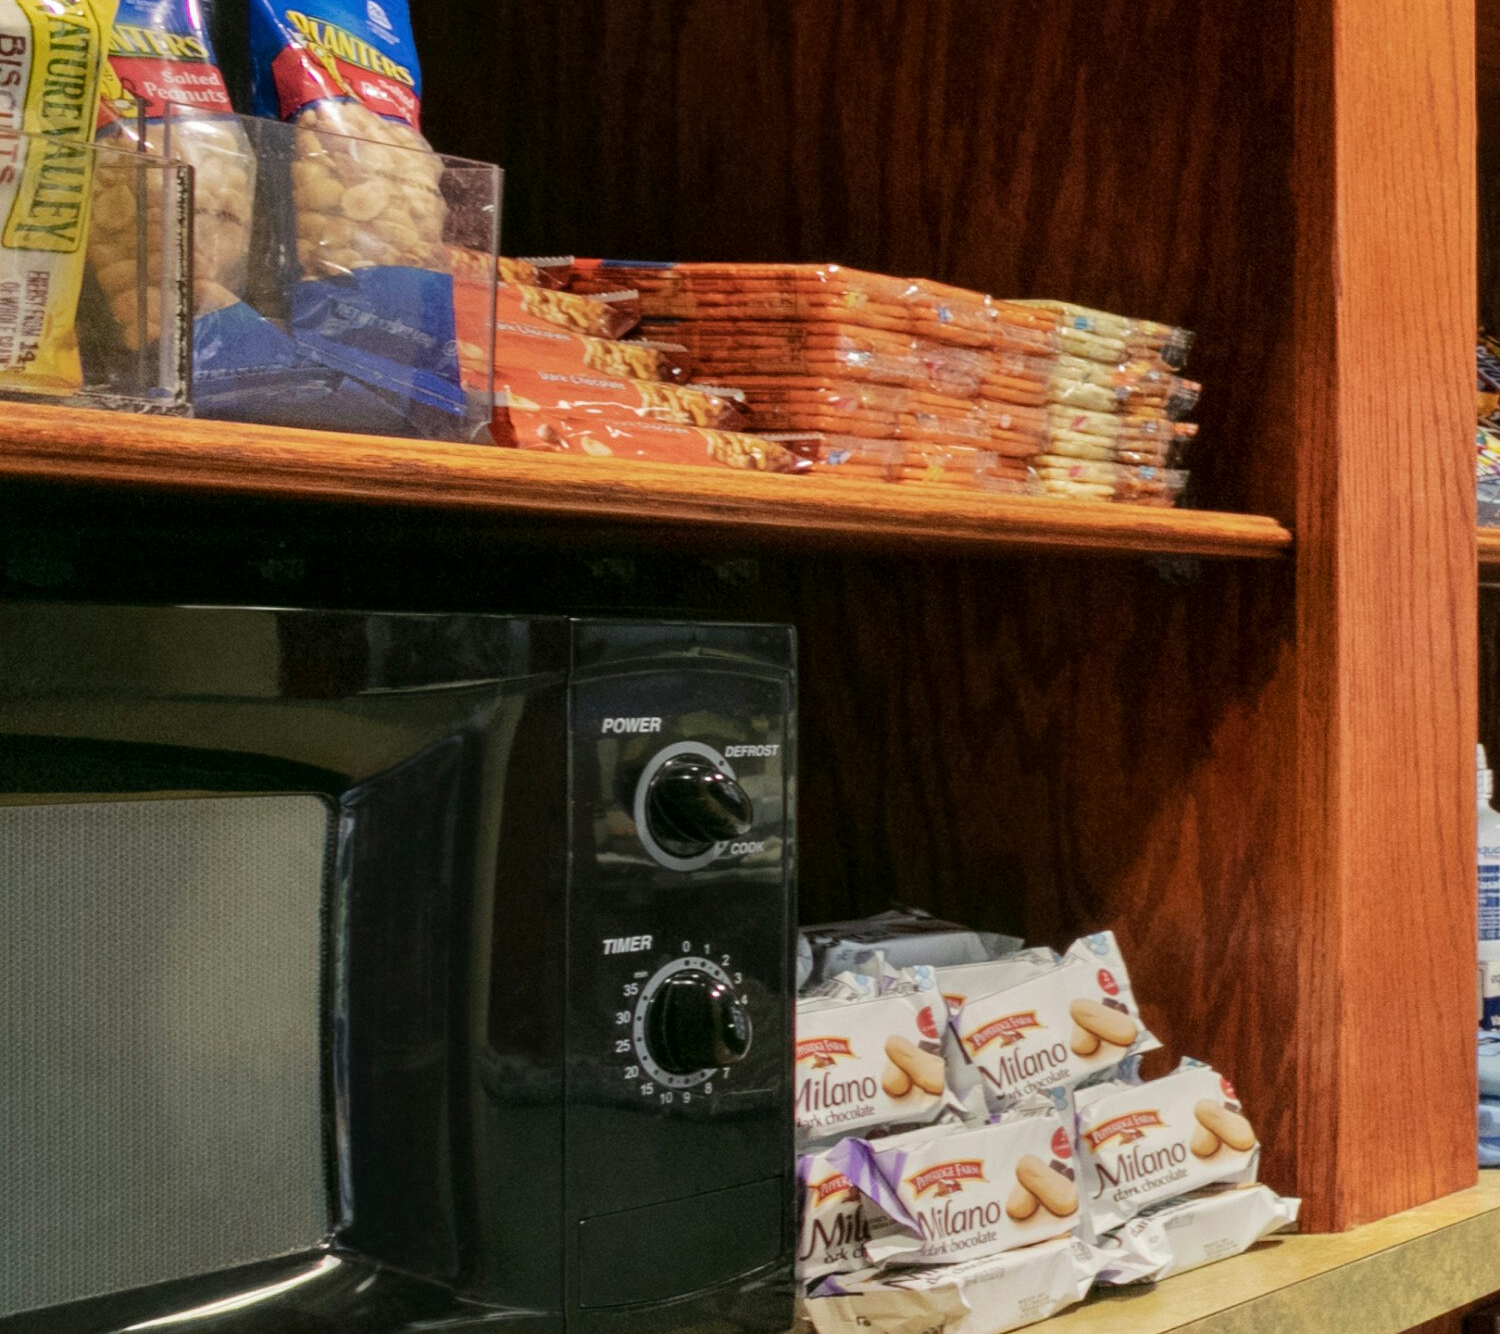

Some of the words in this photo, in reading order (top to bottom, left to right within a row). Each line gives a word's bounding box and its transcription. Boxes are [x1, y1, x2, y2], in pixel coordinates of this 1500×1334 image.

[286, 10, 415, 87] PLANTERS
[162, 69, 220, 87] Salted
[144, 80, 227, 104] Peanuts
[601, 717, 662, 734] POWER
[725, 744, 780, 757] DEFROST
[730, 841, 765, 855] COOK
[602, 935, 653, 955] TIMER
[682, 940, 691, 953] 0
[704, 943, 710, 955] 1
[722, 953, 730, 967] 2
[735, 971, 743, 985] 3
[623, 982, 639, 997] 35
[616, 1011, 632, 1025] 30
[615, 1039, 631, 1053] 25
[624, 1066, 639, 1079] 20
[641, 1083, 654, 1096] 15
[704, 1082, 713, 1095] 8
[660, 1091, 673, 1104] 10
[682, 1091, 691, 1104] 9
[825, 1105, 876, 1125] chocolate
[954, 1160, 985, 1178] FARM
[1091, 1141, 1188, 1201] Milano
[1141, 1167, 1189, 1193] chocolate
